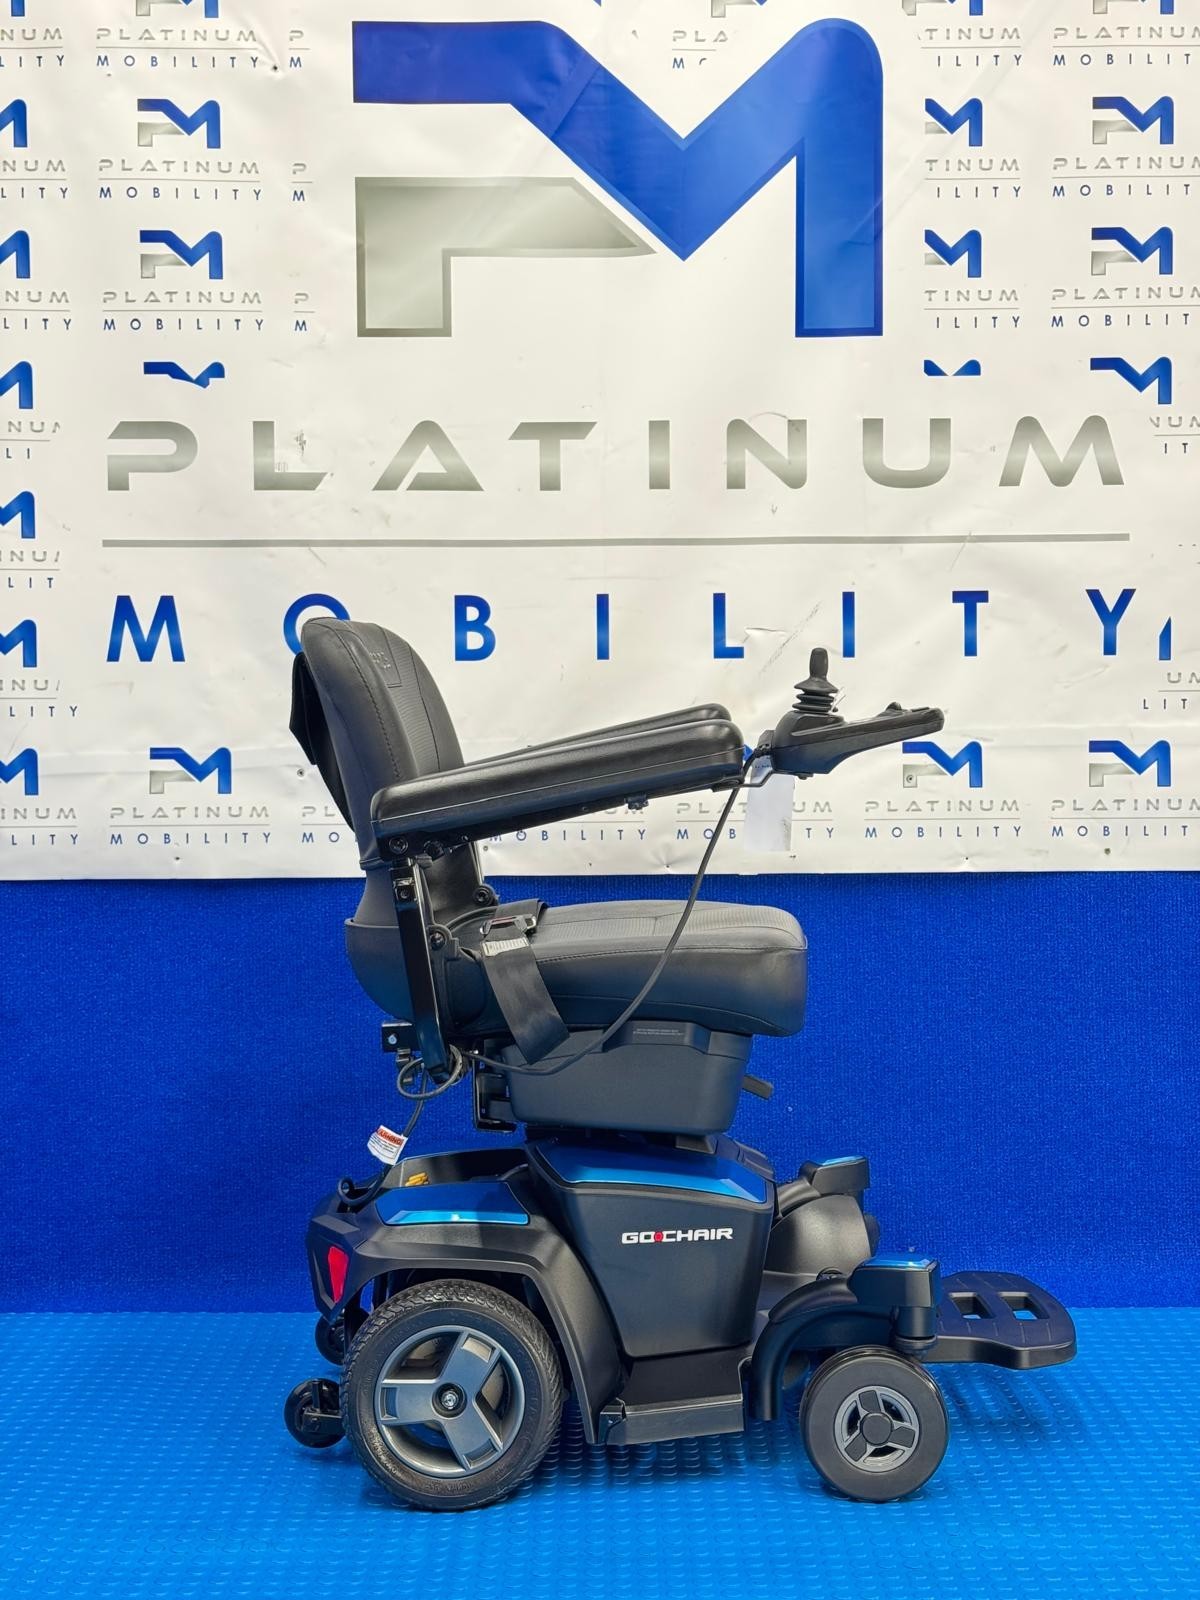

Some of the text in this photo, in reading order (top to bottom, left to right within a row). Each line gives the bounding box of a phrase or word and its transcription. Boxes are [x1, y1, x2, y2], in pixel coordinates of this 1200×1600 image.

[97, 28, 258, 42] PLATINUM
[918, 28, 1020, 40] TINUM
[97, 55, 258, 68] MOBILITY
[99, 159, 259, 174] PLATINUM
[99, 187, 261, 200] MOBILITY
[103, 291, 261, 304] PLATINUM
[104, 318, 263, 330] MOBILITY
[107, 415, 1124, 490] PLATINUM
[106, 588, 1136, 662] MOBILITY
[110, 807, 269, 818] PLATINUM
[866, 800, 1019, 812] PLATINUM
[110, 833, 270, 844] MOBILITY
[676, 827, 834, 840] MOBTY
[865, 826, 1021, 838] MOBILITY
